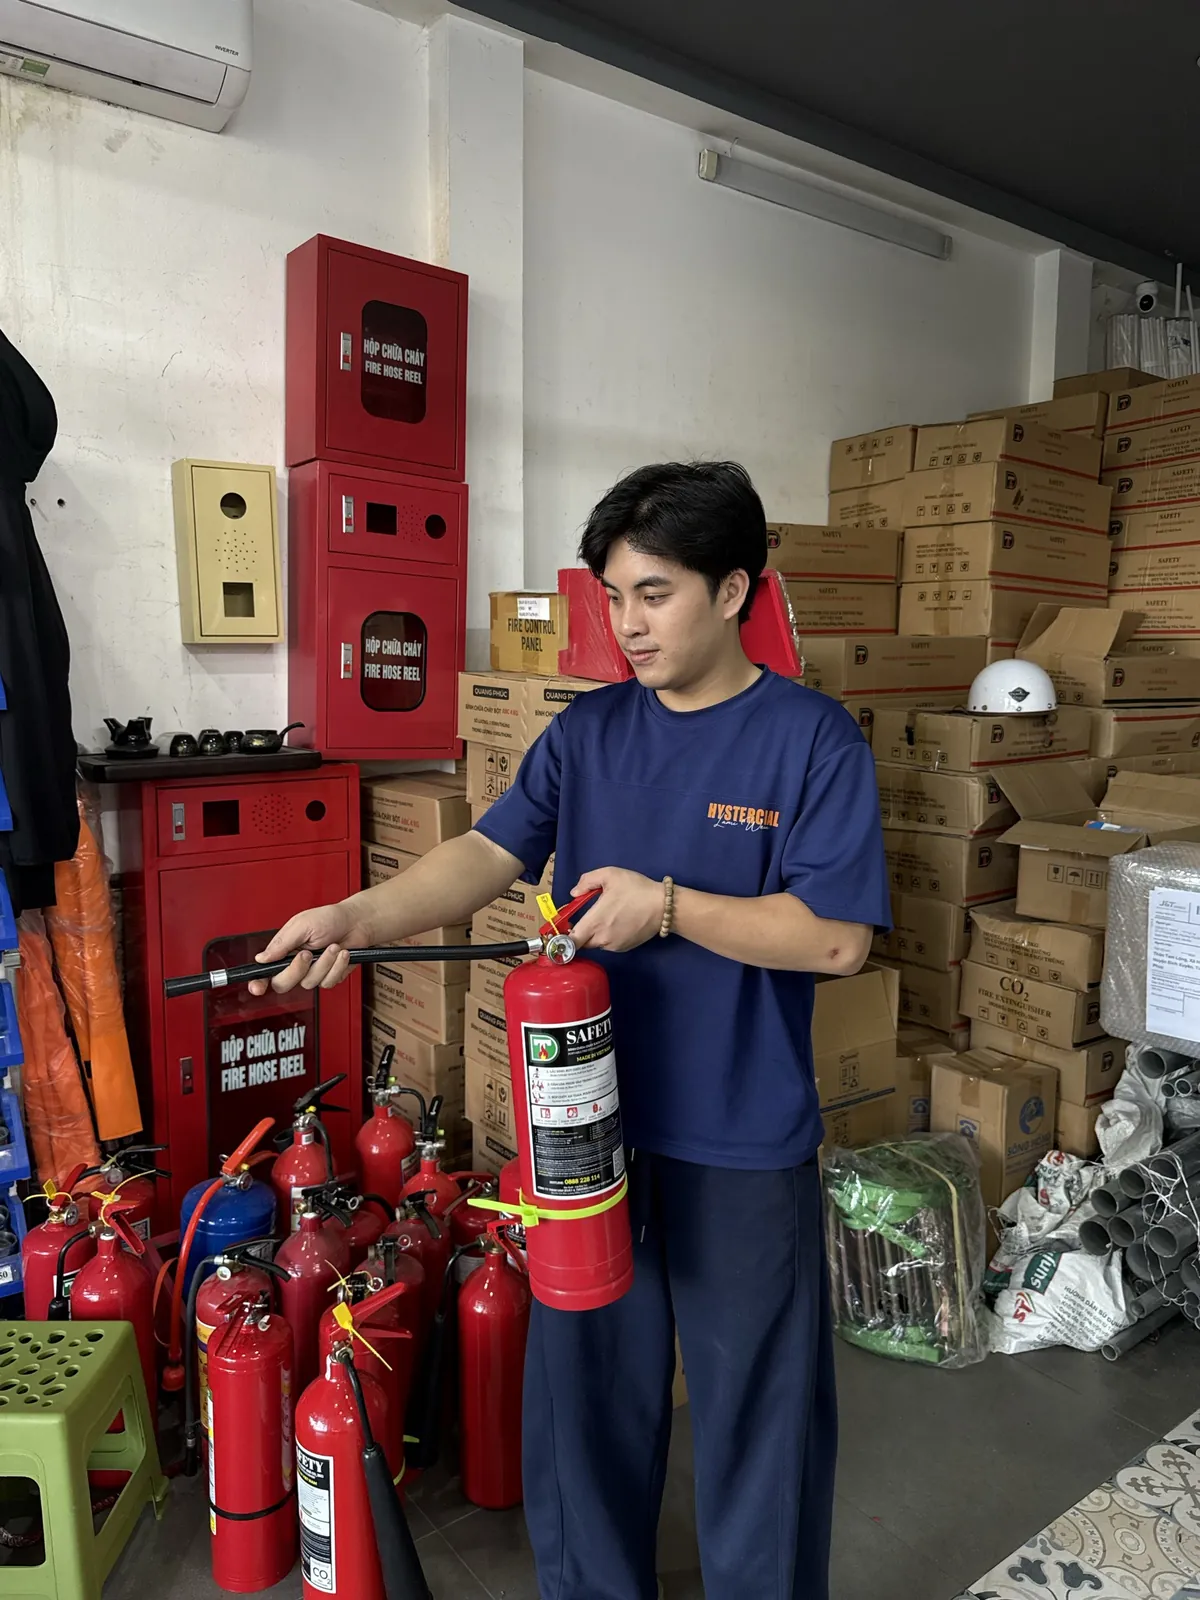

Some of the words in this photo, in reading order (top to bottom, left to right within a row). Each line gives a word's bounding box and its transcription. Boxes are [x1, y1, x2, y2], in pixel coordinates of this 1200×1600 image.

[214, 44, 239, 56] INVERTER
[363, 337, 380, 358] HỘP
[381, 342, 403, 362] CHỮA
[404, 348, 425, 367] CHÁY
[365, 360, 382, 375] FIRE
[383, 364, 403, 380] HOSE
[404, 369, 423, 385] REEL
[1167, 379, 1189, 388] SAFETY
[1169, 425, 1191, 433] SAFETY
[1171, 467, 1195, 476] SAFETY
[1159, 512, 1182, 520] SAFETY
[507, 618, 523, 632] FIRE
[524, 618, 556, 635] CONTROL
[365, 636, 380, 657] HỘP
[381, 638, 401, 656] CHỮA
[402, 640, 422, 657] CHÁY
[521, 636, 543, 652] PANEL
[364, 663, 381, 679] FIRE
[382, 664, 402, 680] HOSE
[403, 665, 421, 681] REEL
[474, 687, 492, 696] QUANG
[545, 691, 567, 700] QUANG
[978, 988, 994, 999] FIRE
[995, 992, 1052, 1018] EXTINGUISHER
[221, 1034, 244, 1067] HỘP
[246, 1028, 276, 1059] CHỮA
[278, 1022, 306, 1052] CHÁY
[221, 1066, 247, 1093] FIRE
[248, 1059, 278, 1087] HOSE
[279, 1053, 306, 1080] REEL
